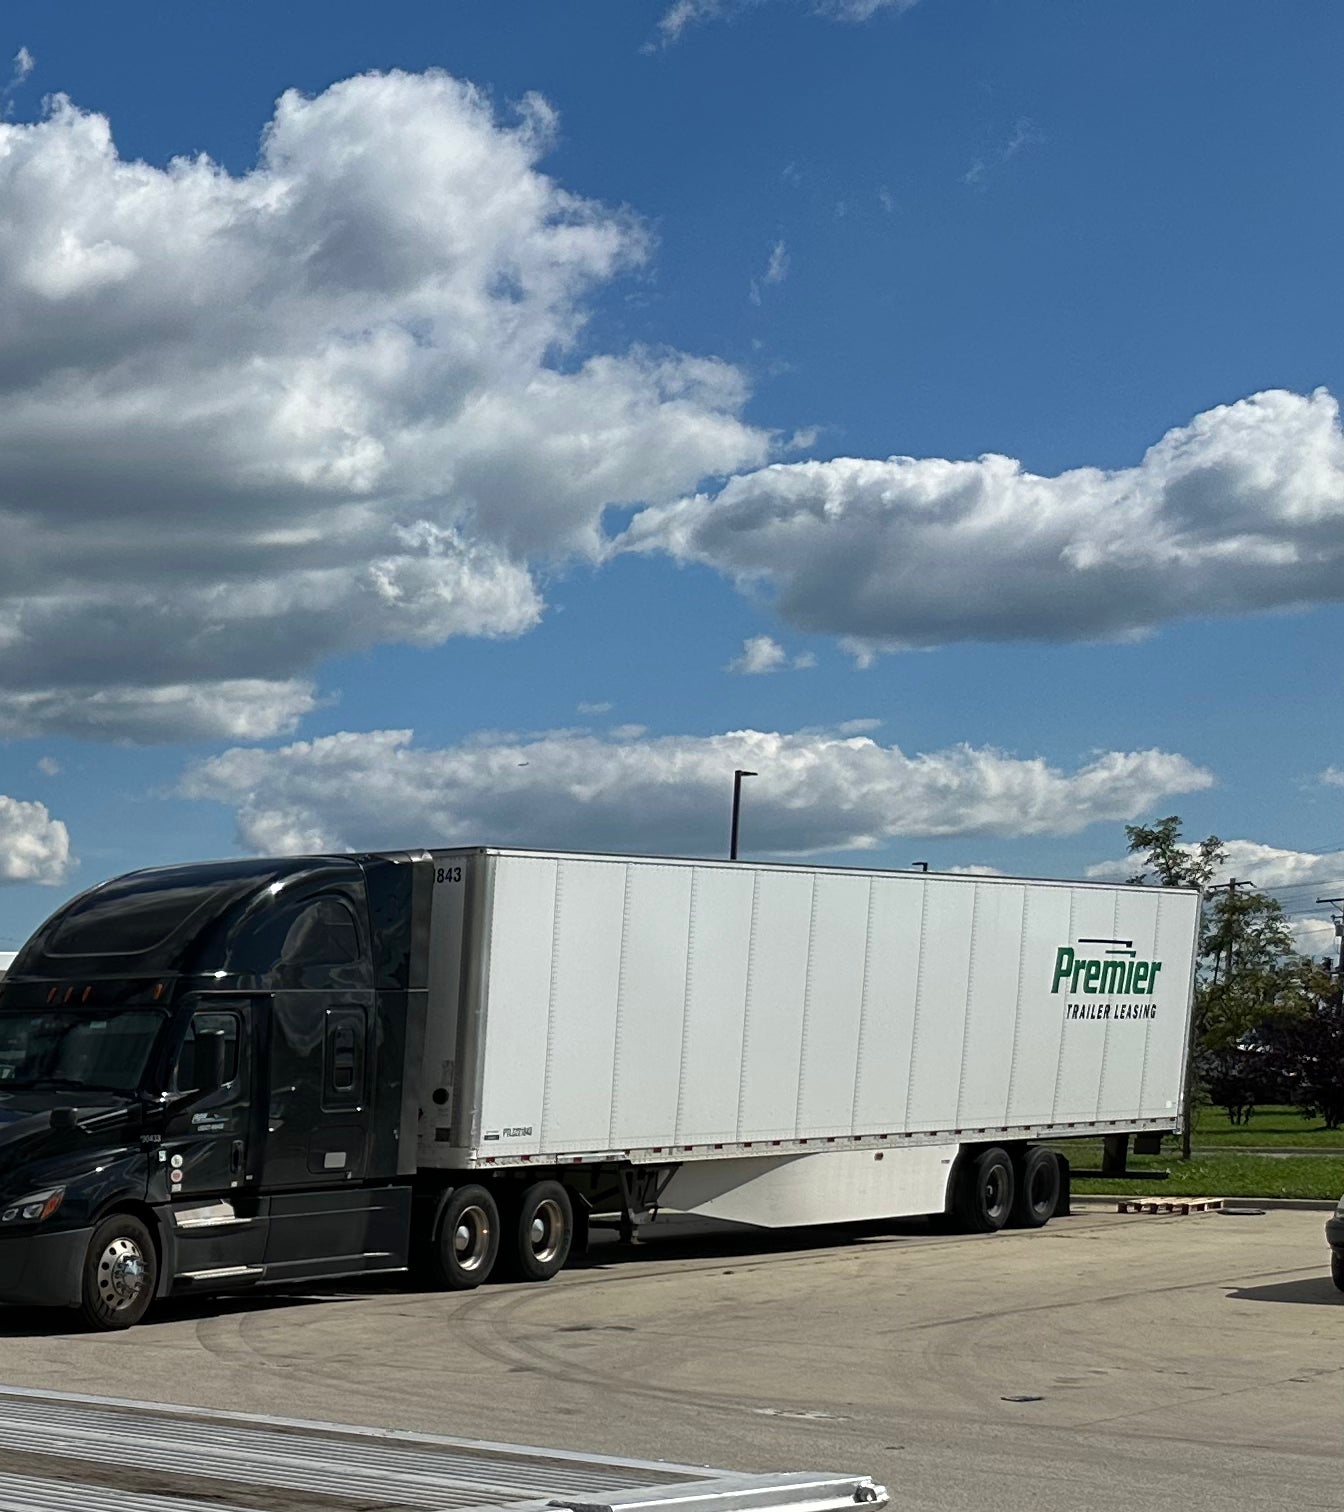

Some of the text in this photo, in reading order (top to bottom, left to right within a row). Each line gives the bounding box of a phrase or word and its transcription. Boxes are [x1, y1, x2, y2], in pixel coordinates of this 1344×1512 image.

[433, 867, 462, 883] 843
[1050, 946, 1162, 995] Premier
[1066, 1003, 1157, 1020] TRAILER LEASING
